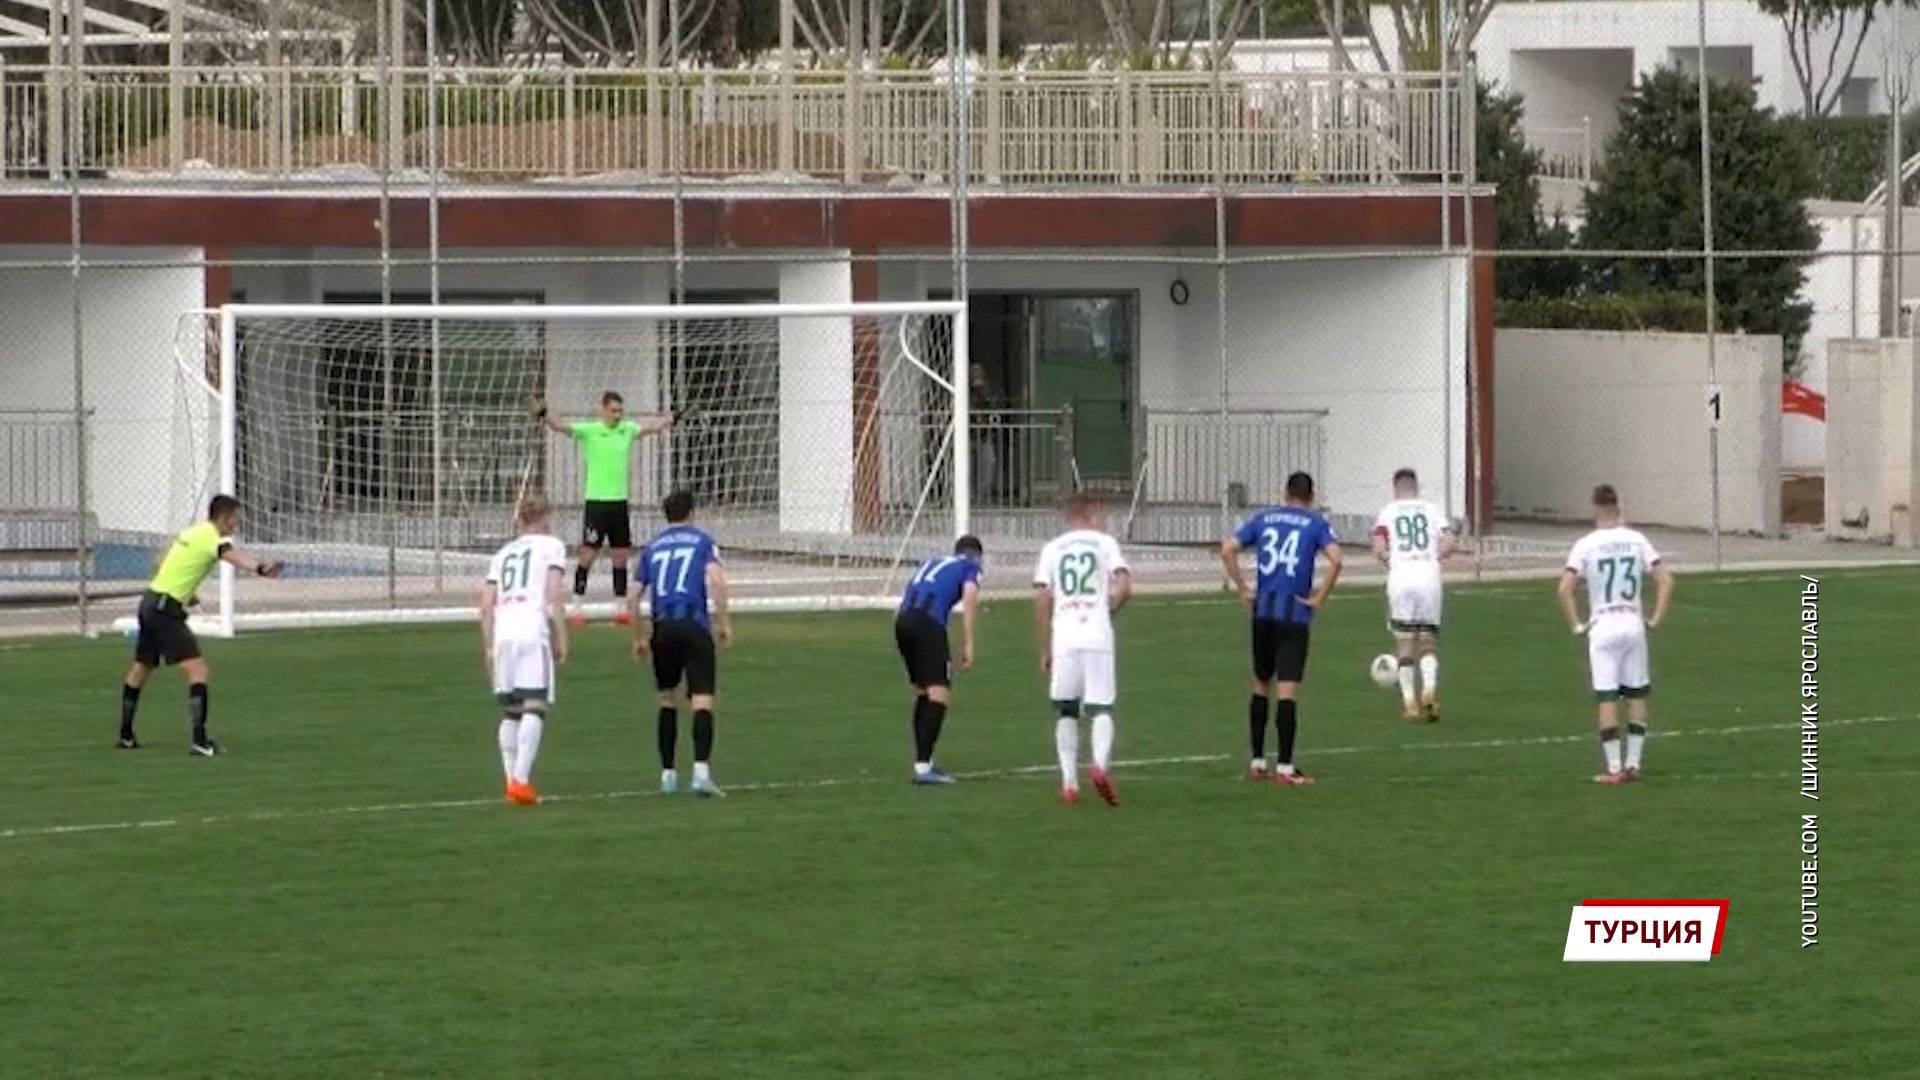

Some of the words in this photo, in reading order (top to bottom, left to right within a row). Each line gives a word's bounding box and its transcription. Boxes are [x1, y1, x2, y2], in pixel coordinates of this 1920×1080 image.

[1709, 392, 1721, 420] 1
[1259, 527, 1300, 577] 34
[1394, 512, 1429, 552] 98
[501, 548, 532, 592] 61
[650, 547, 696, 597] 77
[1059, 550, 1096, 596] 62
[1597, 556, 1637, 603] 73
